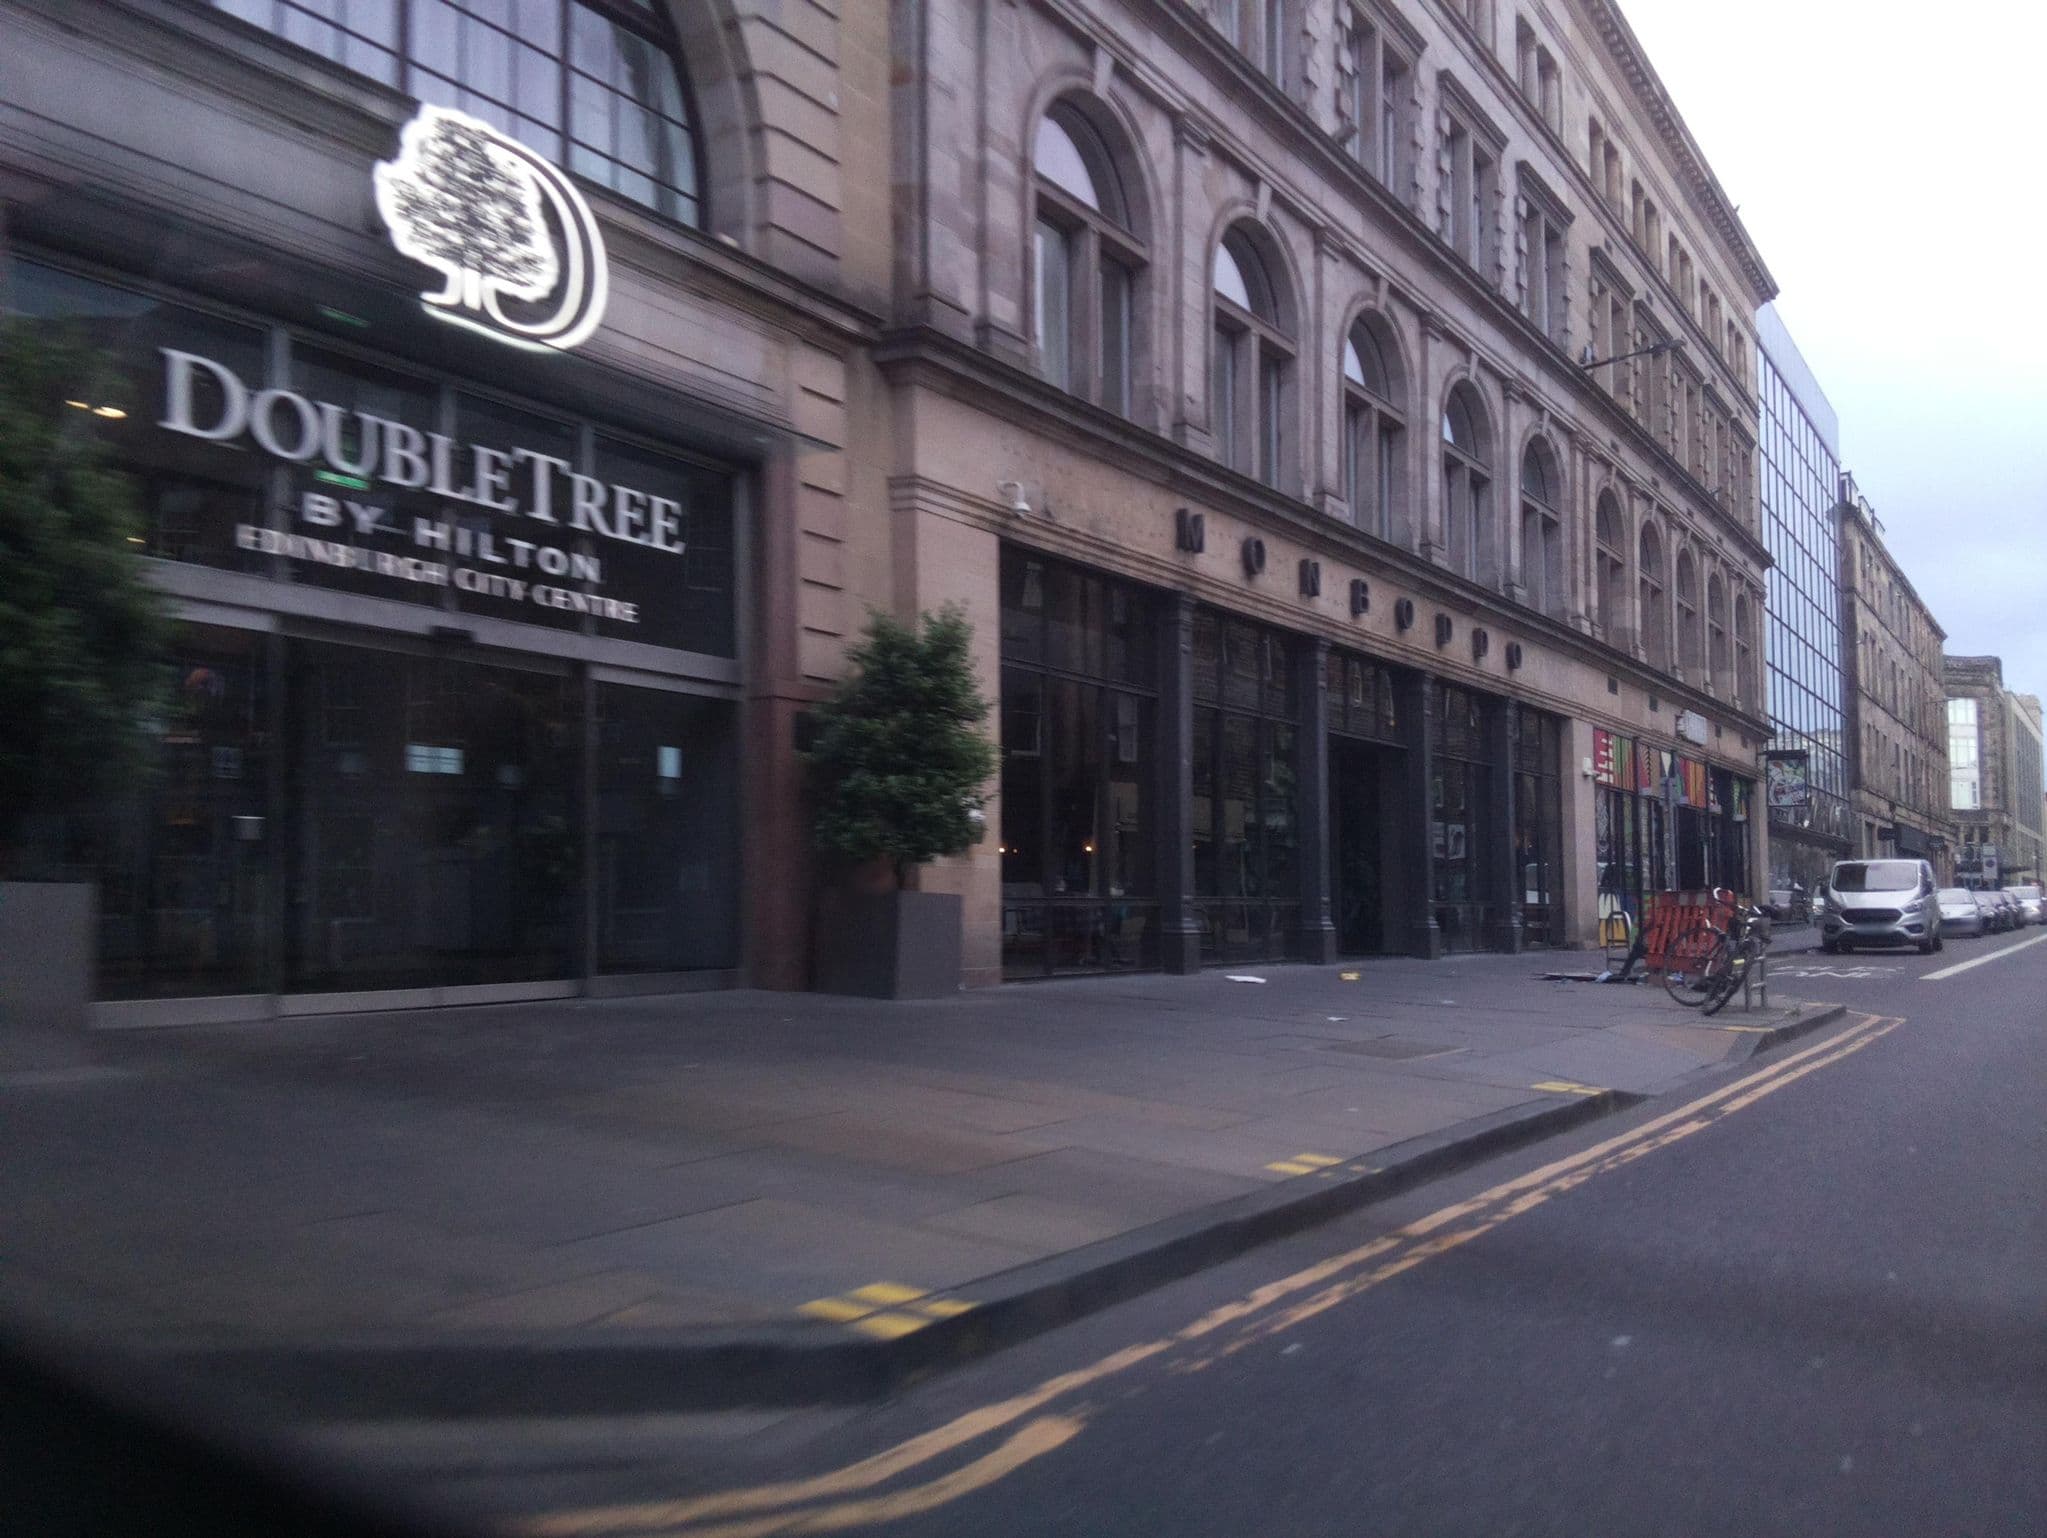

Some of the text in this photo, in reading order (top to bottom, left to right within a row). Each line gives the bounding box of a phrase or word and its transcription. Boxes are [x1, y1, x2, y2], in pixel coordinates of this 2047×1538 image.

[158, 346, 686, 555] DOUBLETREE
[235, 522, 640, 624] EDINBURGH CITY CENTRE
[302, 491, 602, 584] BY HILTON
